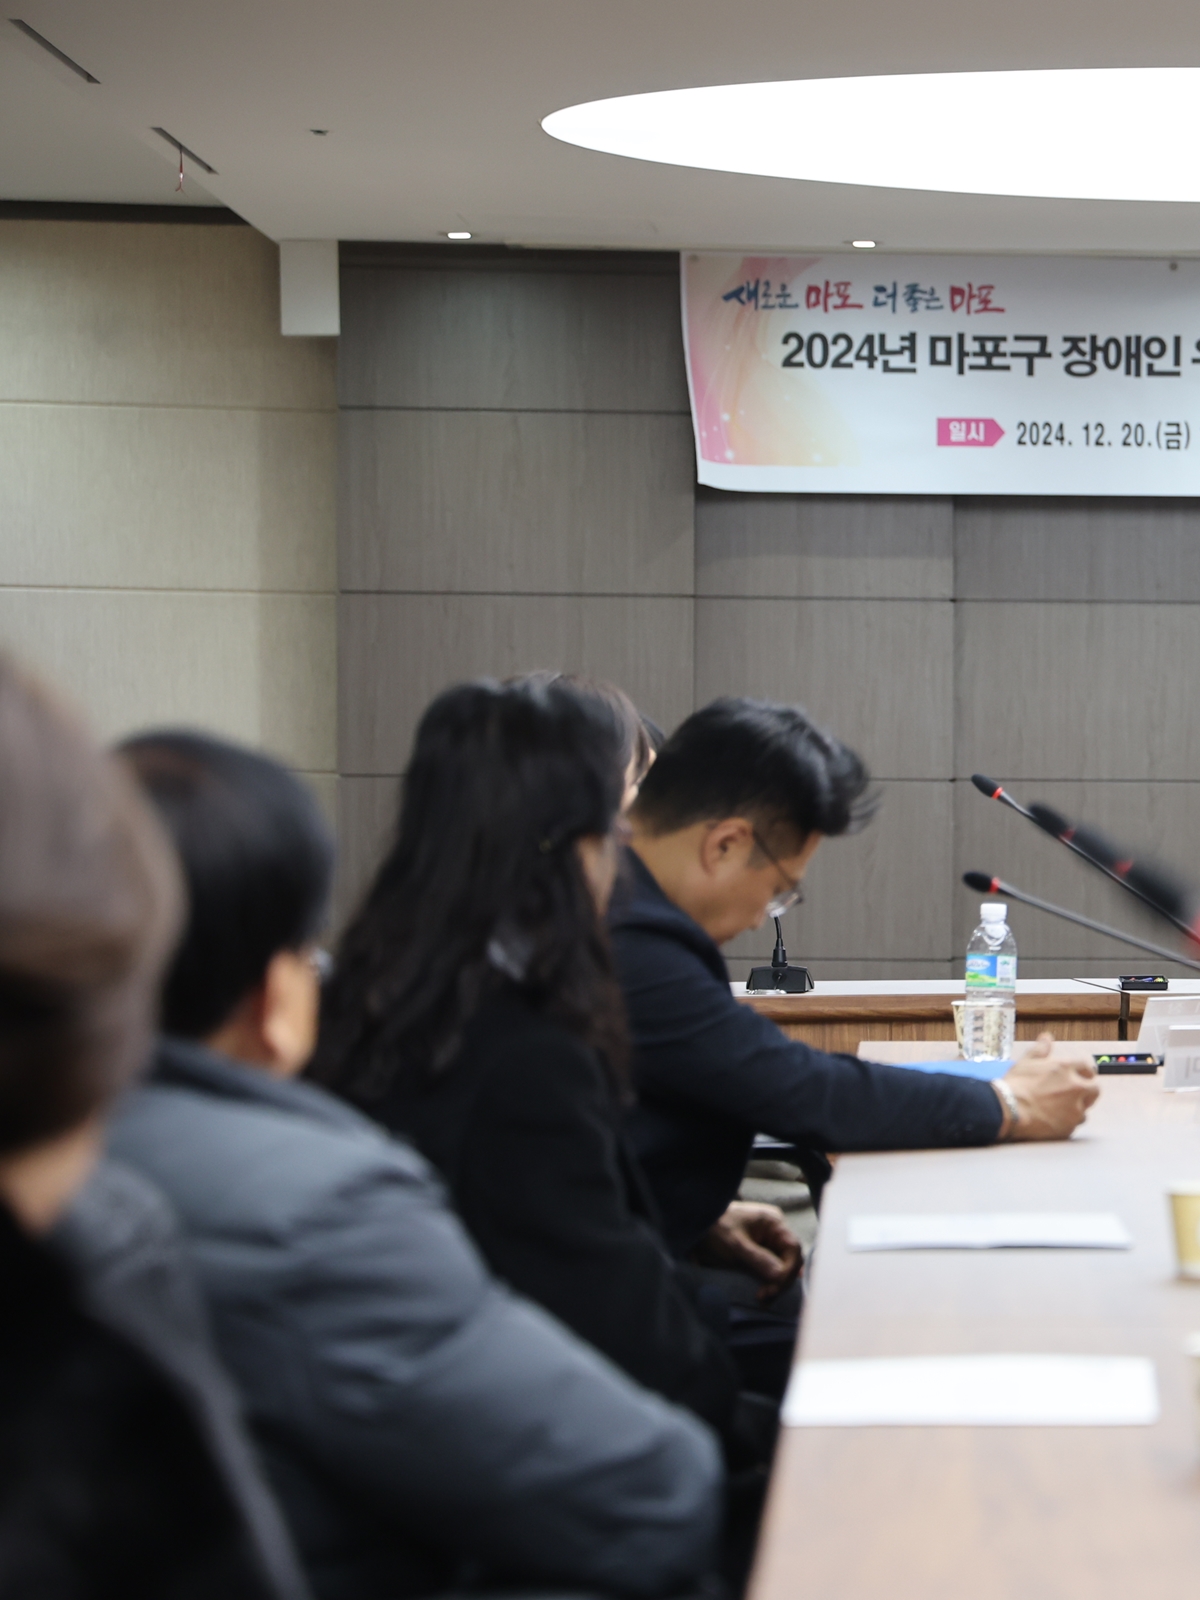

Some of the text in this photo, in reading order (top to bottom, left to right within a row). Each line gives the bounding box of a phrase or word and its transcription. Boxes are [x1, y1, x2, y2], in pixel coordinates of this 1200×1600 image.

[722, 277, 1006, 315] 새로운 마포 더 좋은 마포
[781, 331, 918, 374] 2024년
[929, 332, 1053, 376] 마포구
[1061, 333, 1182, 378] 장애인
[949, 421, 985, 442] 일시
[1016, 421, 1072, 447] 2024.
[1083, 422, 1112, 447] 12.
[1121, 420, 1190, 450] 20.(금)
